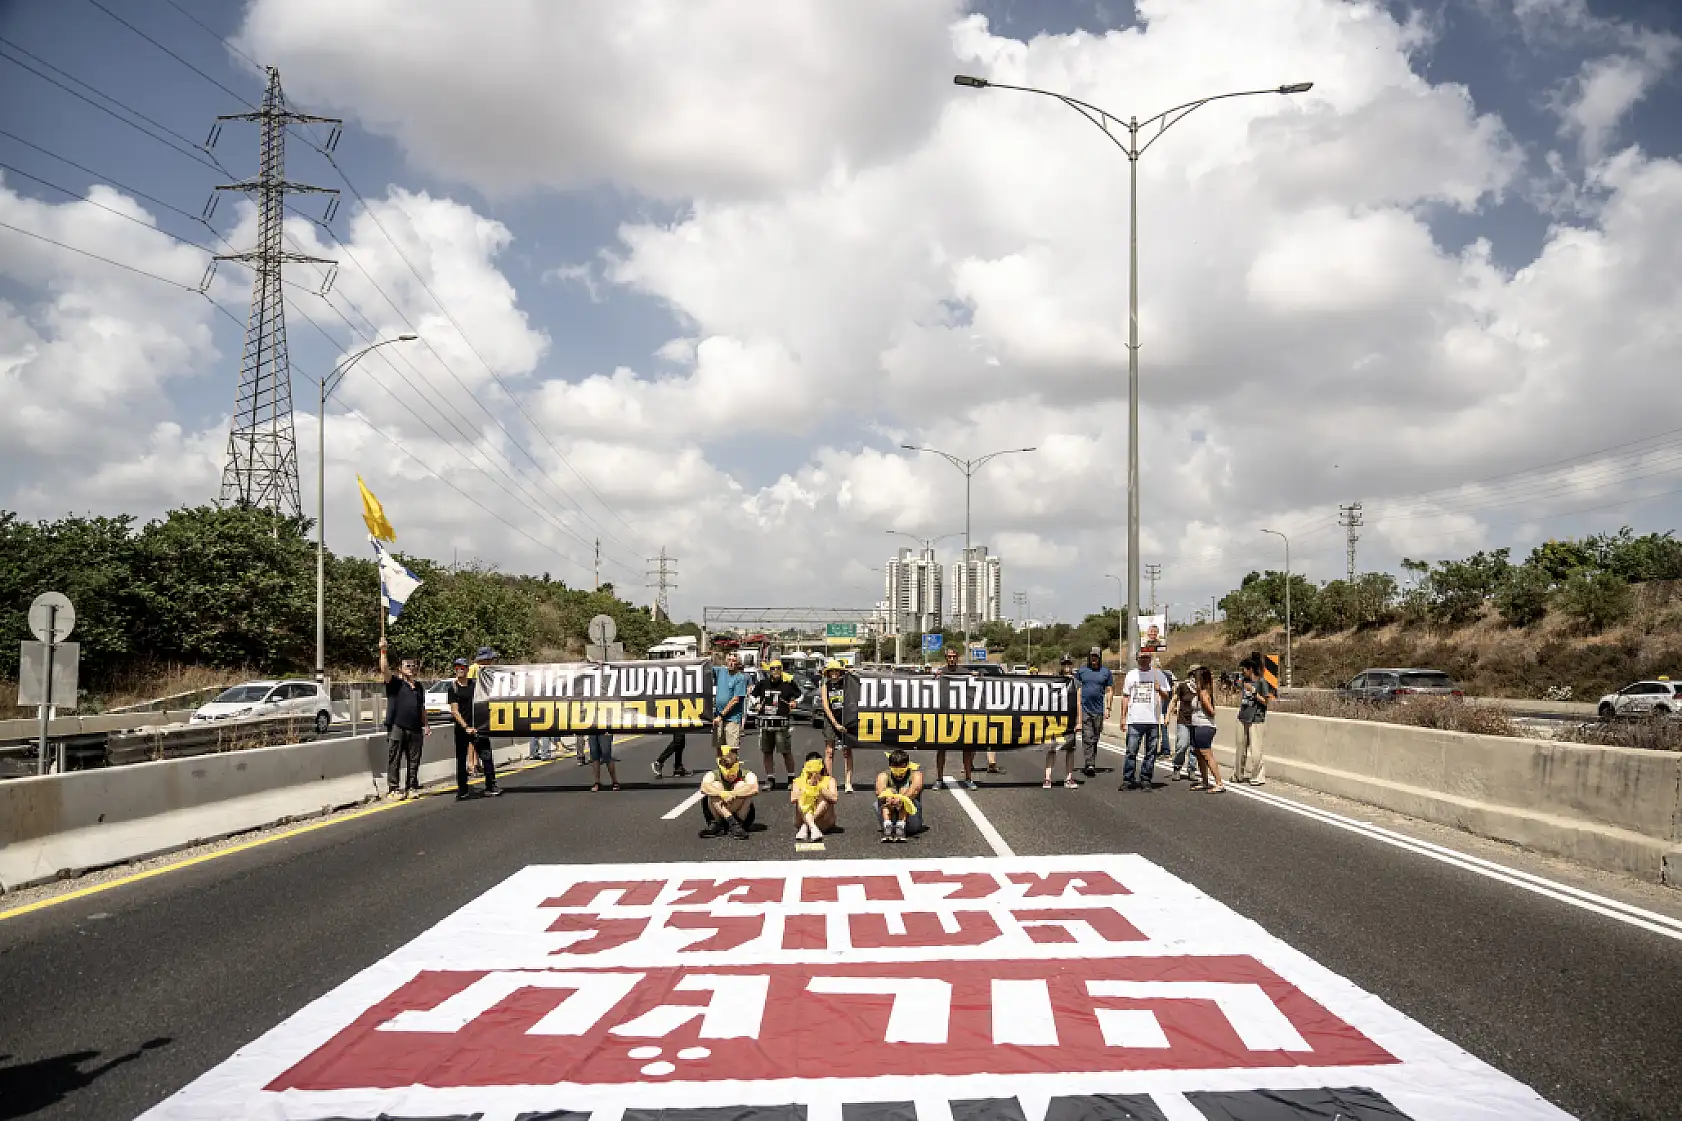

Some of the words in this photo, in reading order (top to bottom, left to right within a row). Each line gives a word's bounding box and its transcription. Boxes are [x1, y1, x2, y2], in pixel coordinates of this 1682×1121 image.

[489, 669, 575, 697] הורגת
[583, 664, 704, 697] הממשלה
[857, 677, 941, 710] הורגת
[949, 675, 1068, 712] הממשלה
[488, 700, 647, 731] החטופים
[653, 697, 704, 728] את
[857, 711, 1013, 745] החטופים
[1017, 715, 1068, 745] את
[537, 870, 1135, 908] מלחמת
[543, 906, 1151, 956] השולל
